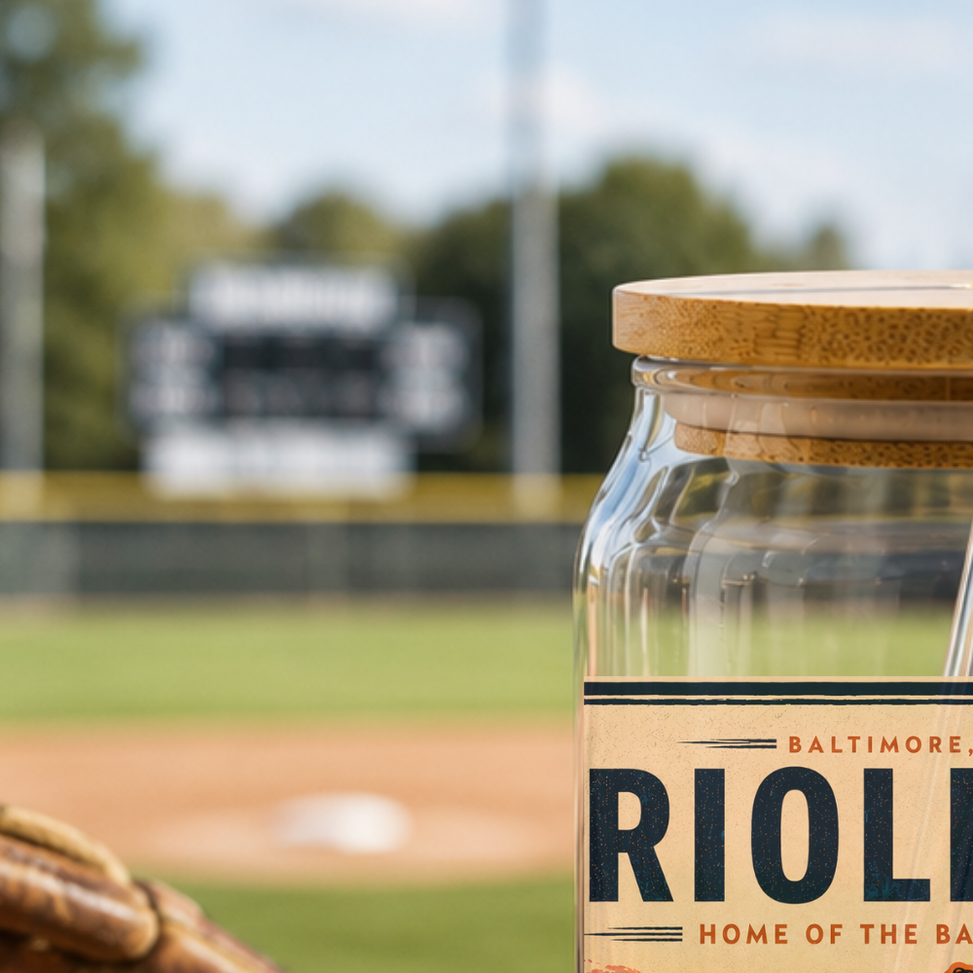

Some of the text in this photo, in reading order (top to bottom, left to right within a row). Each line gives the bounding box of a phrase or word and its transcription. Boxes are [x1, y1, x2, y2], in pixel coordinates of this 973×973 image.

[699, 923, 788, 945] HOME
[805, 923, 843, 945] OF
[859, 923, 918, 945] THE
